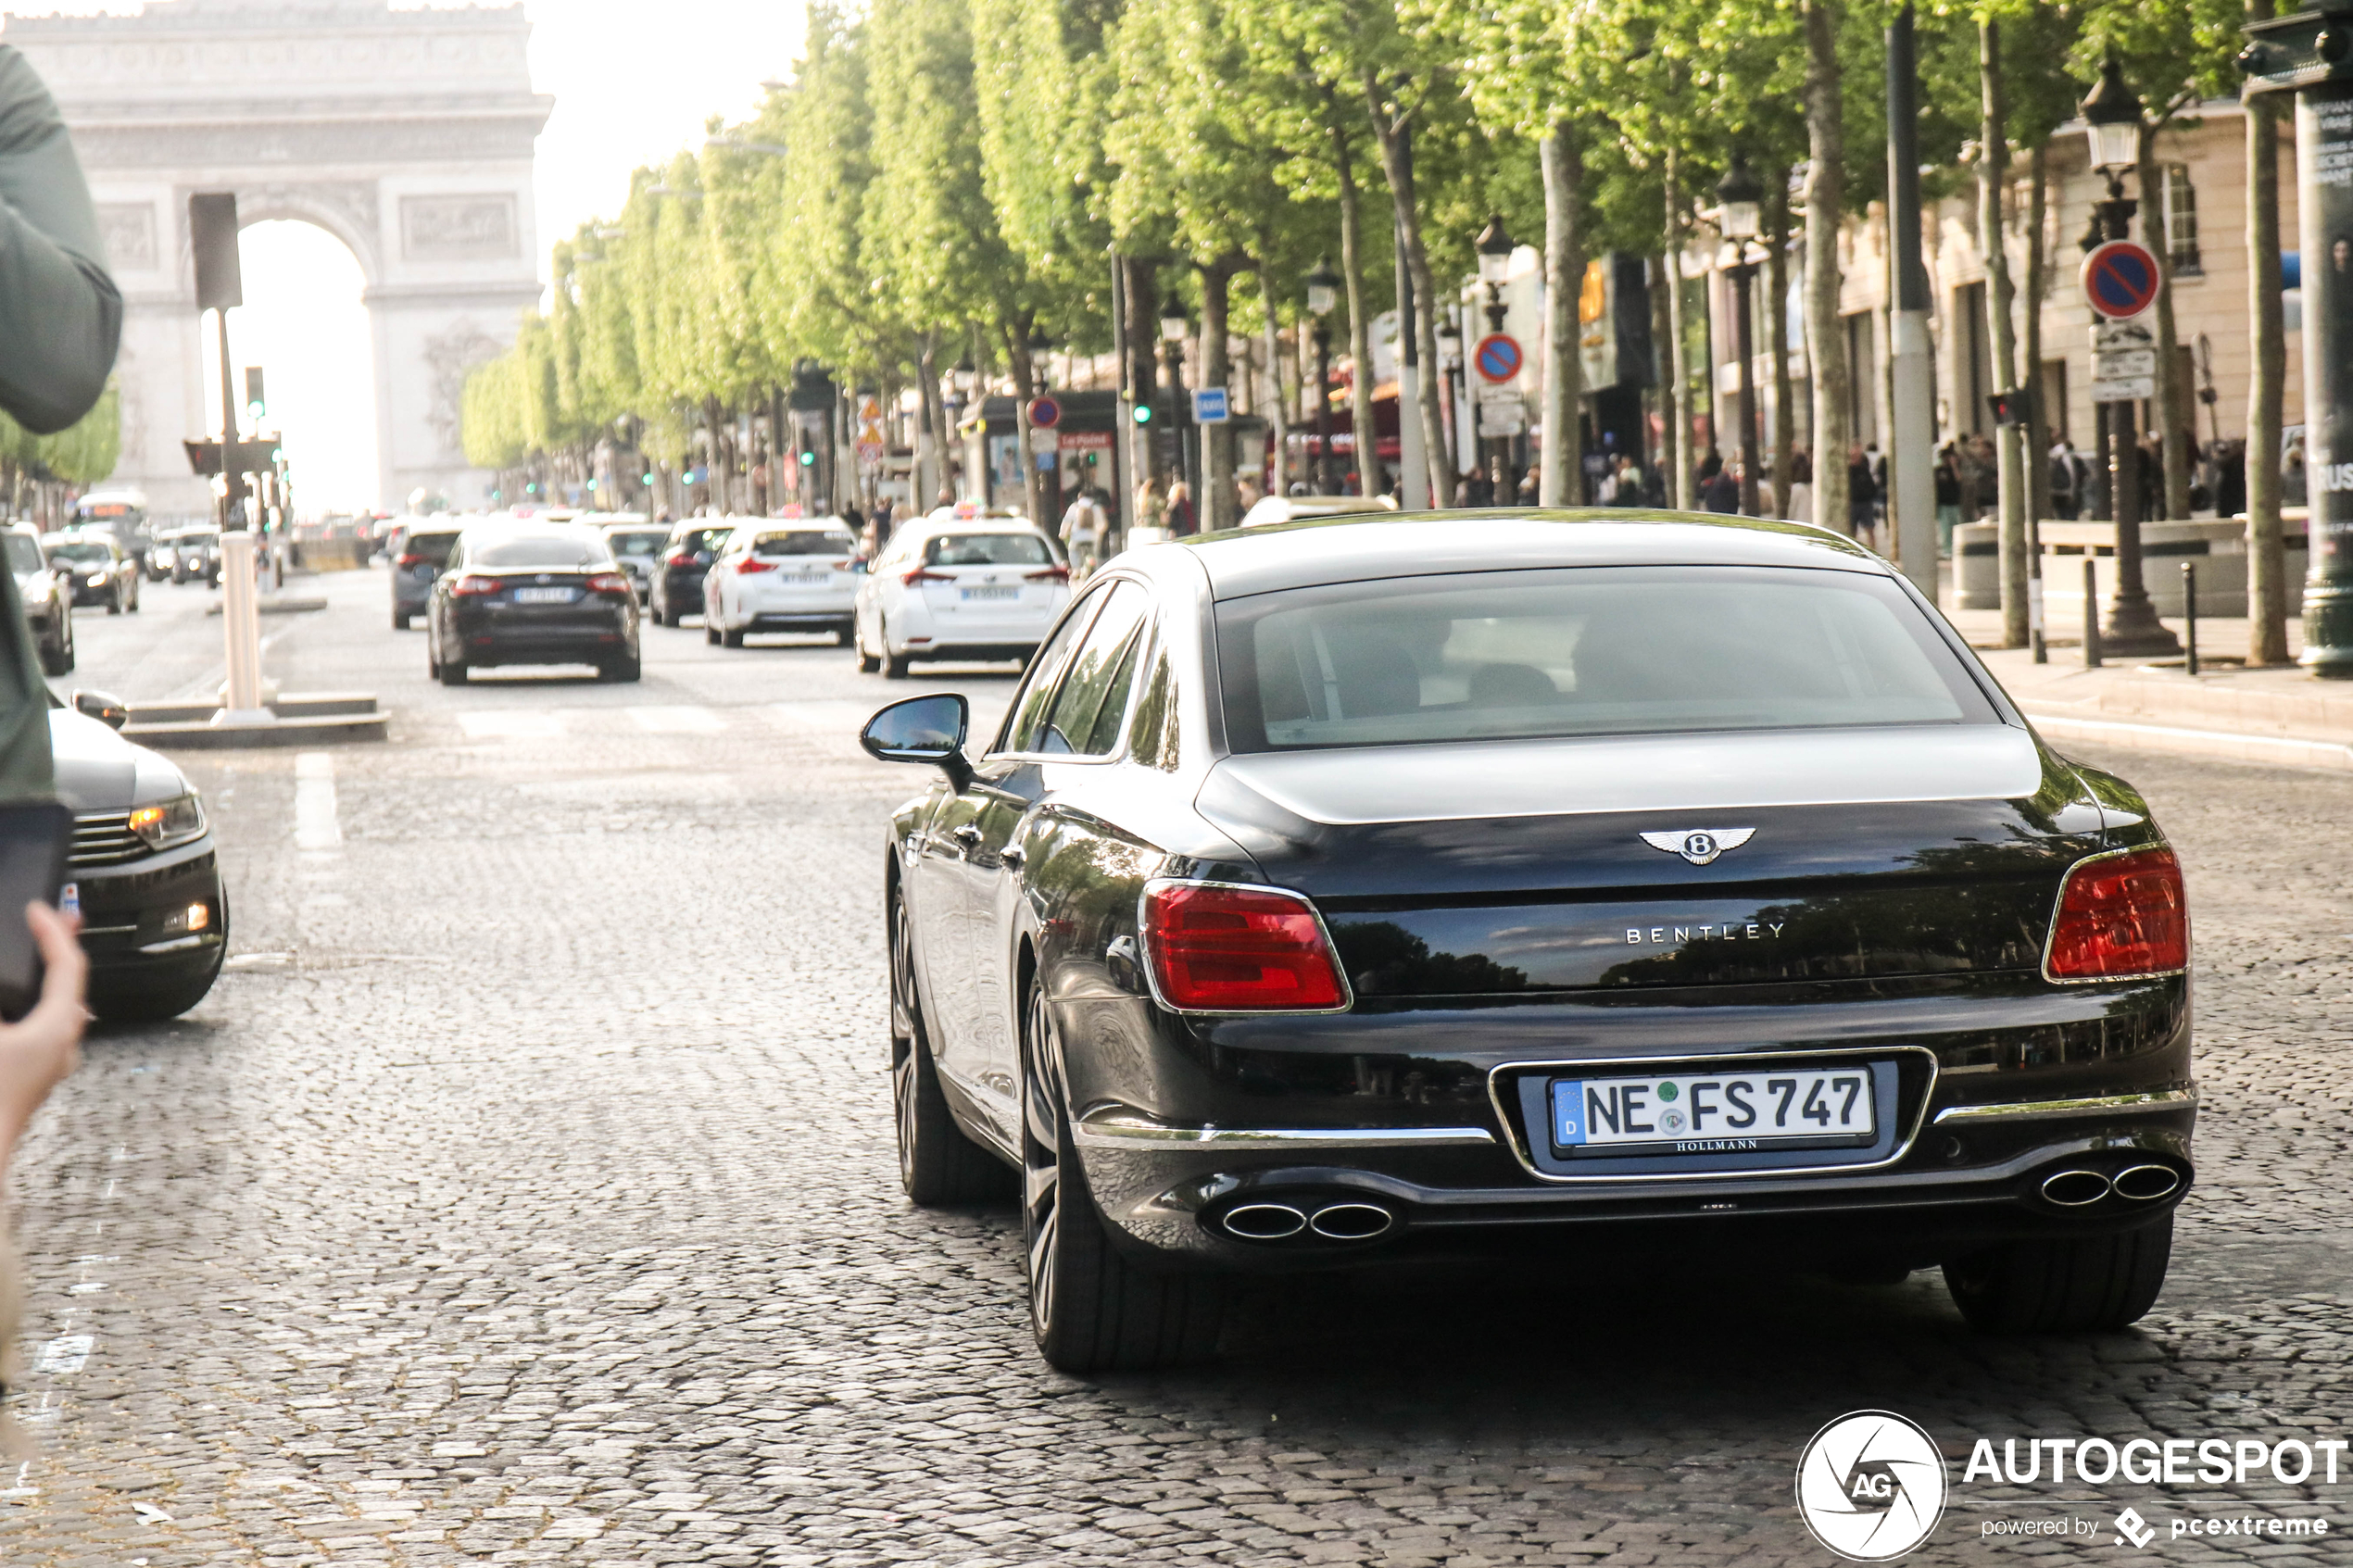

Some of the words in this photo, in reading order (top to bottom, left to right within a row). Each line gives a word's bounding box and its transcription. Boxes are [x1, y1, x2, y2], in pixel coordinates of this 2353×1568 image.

[1626, 923, 1783, 944] BENTLEY
[1586, 1085, 1655, 1135] NE
[1690, 1081, 1756, 1130] FS
[1768, 1078, 1861, 1126] 747
[1566, 1121, 1577, 1135] D
[1677, 1140, 1757, 1152] HOLLMANN
